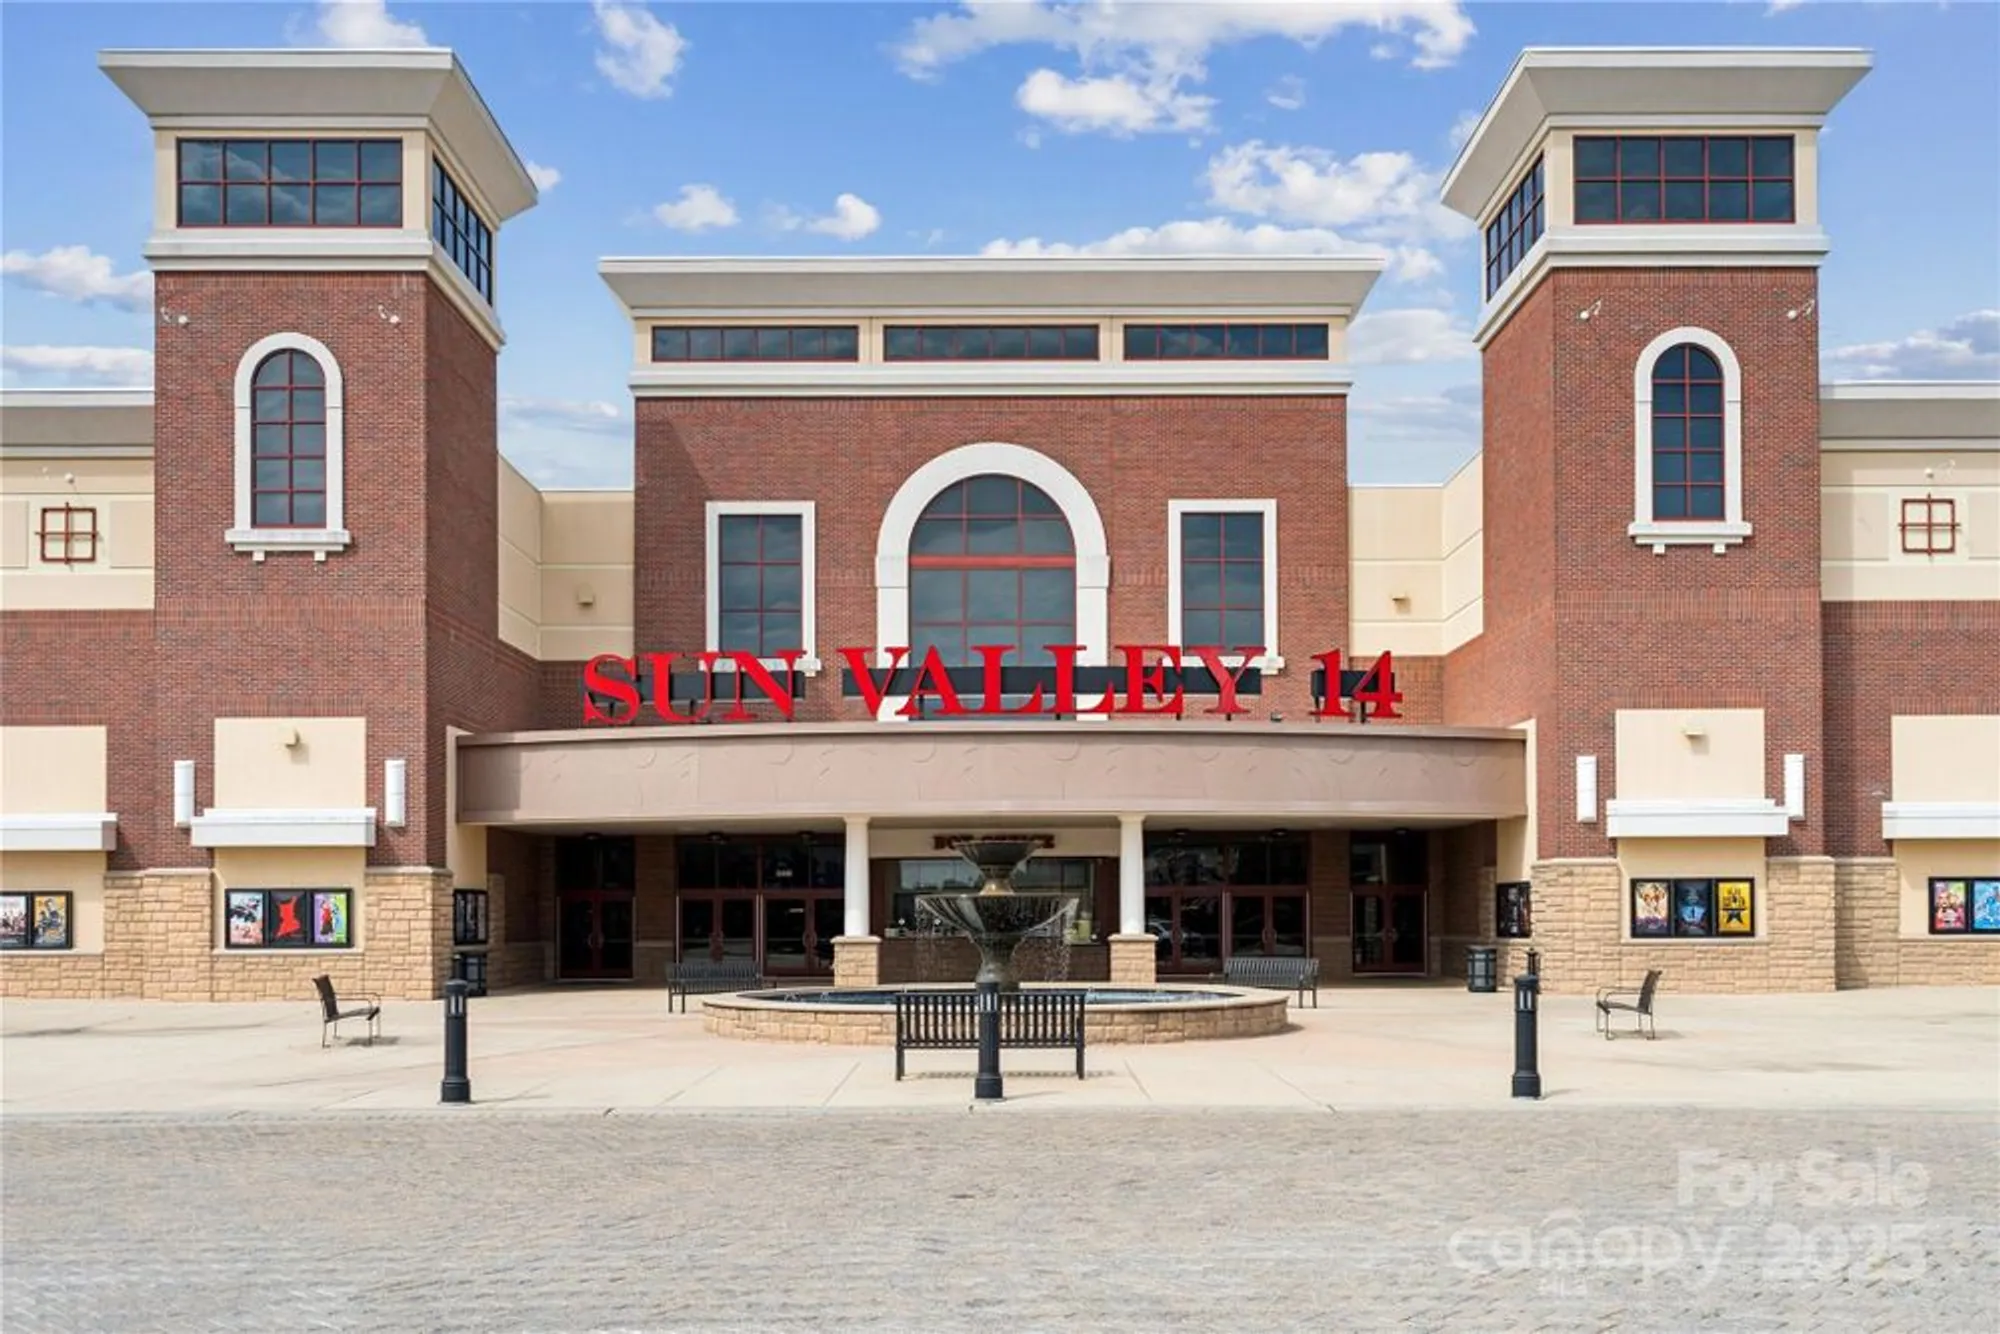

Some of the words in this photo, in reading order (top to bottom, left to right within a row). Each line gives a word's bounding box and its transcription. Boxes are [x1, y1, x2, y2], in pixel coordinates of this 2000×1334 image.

[583, 650, 807, 725] SUN
[837, 644, 1267, 718] VALLEY
[1308, 648, 1403, 718] 14
